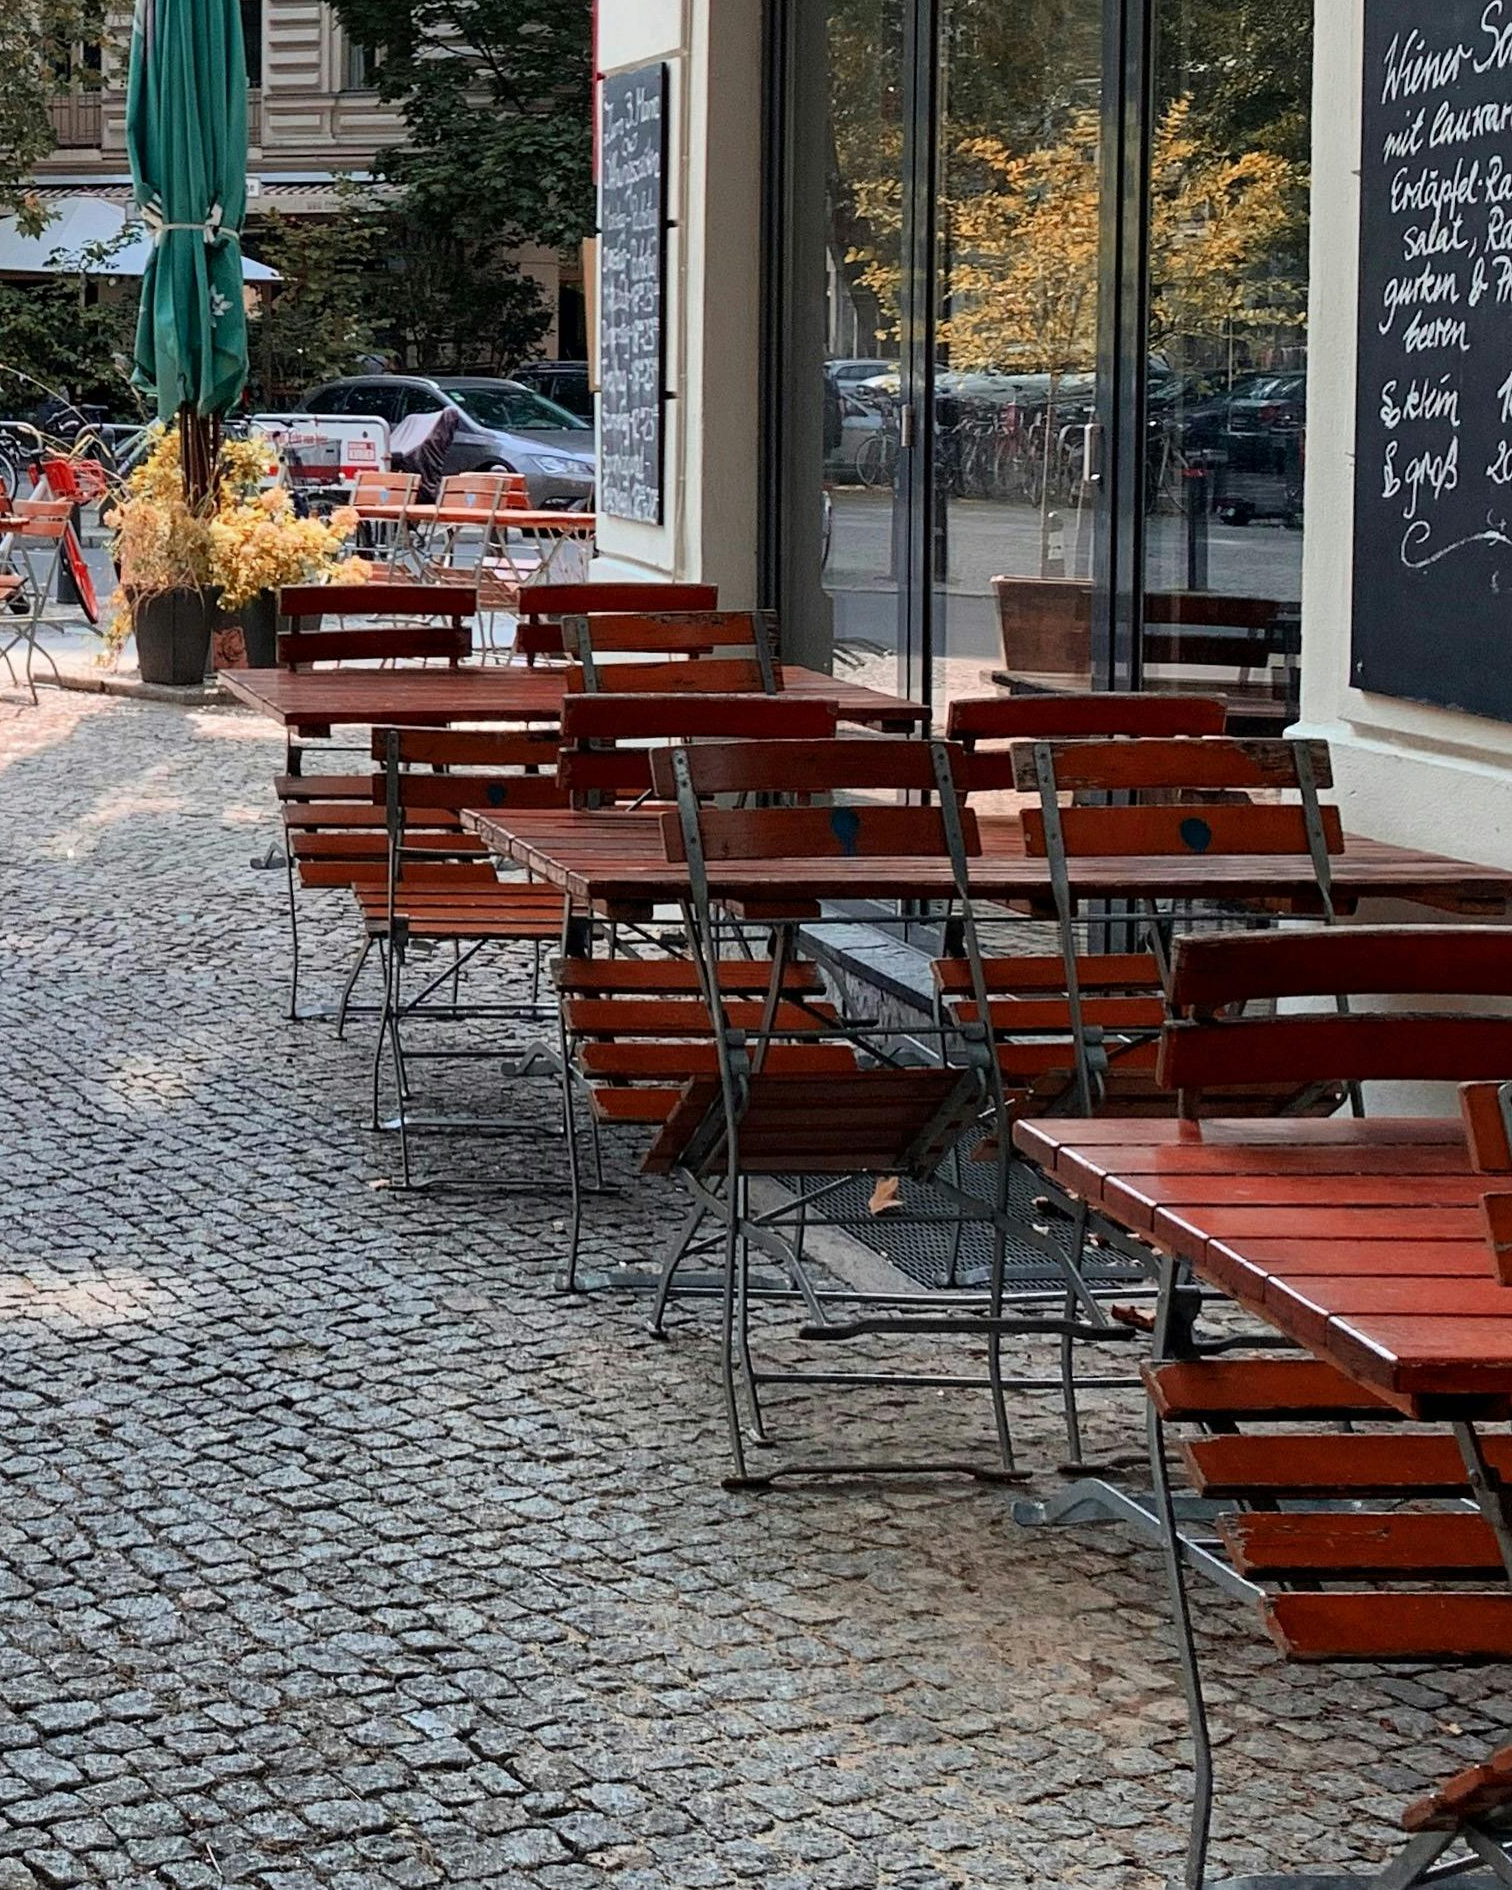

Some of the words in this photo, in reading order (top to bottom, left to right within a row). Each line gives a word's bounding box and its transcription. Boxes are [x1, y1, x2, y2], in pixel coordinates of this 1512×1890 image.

[1381, 29, 1474, 104] Wiener
[1383, 107, 1426, 163] mit
[1429, 101, 1512, 148] lauwar
[1379, 262, 1460, 334] gurken
[1403, 310, 1471, 353] beeren
[1403, 373, 1461, 427] klein
[1403, 435, 1458, 519] groß
